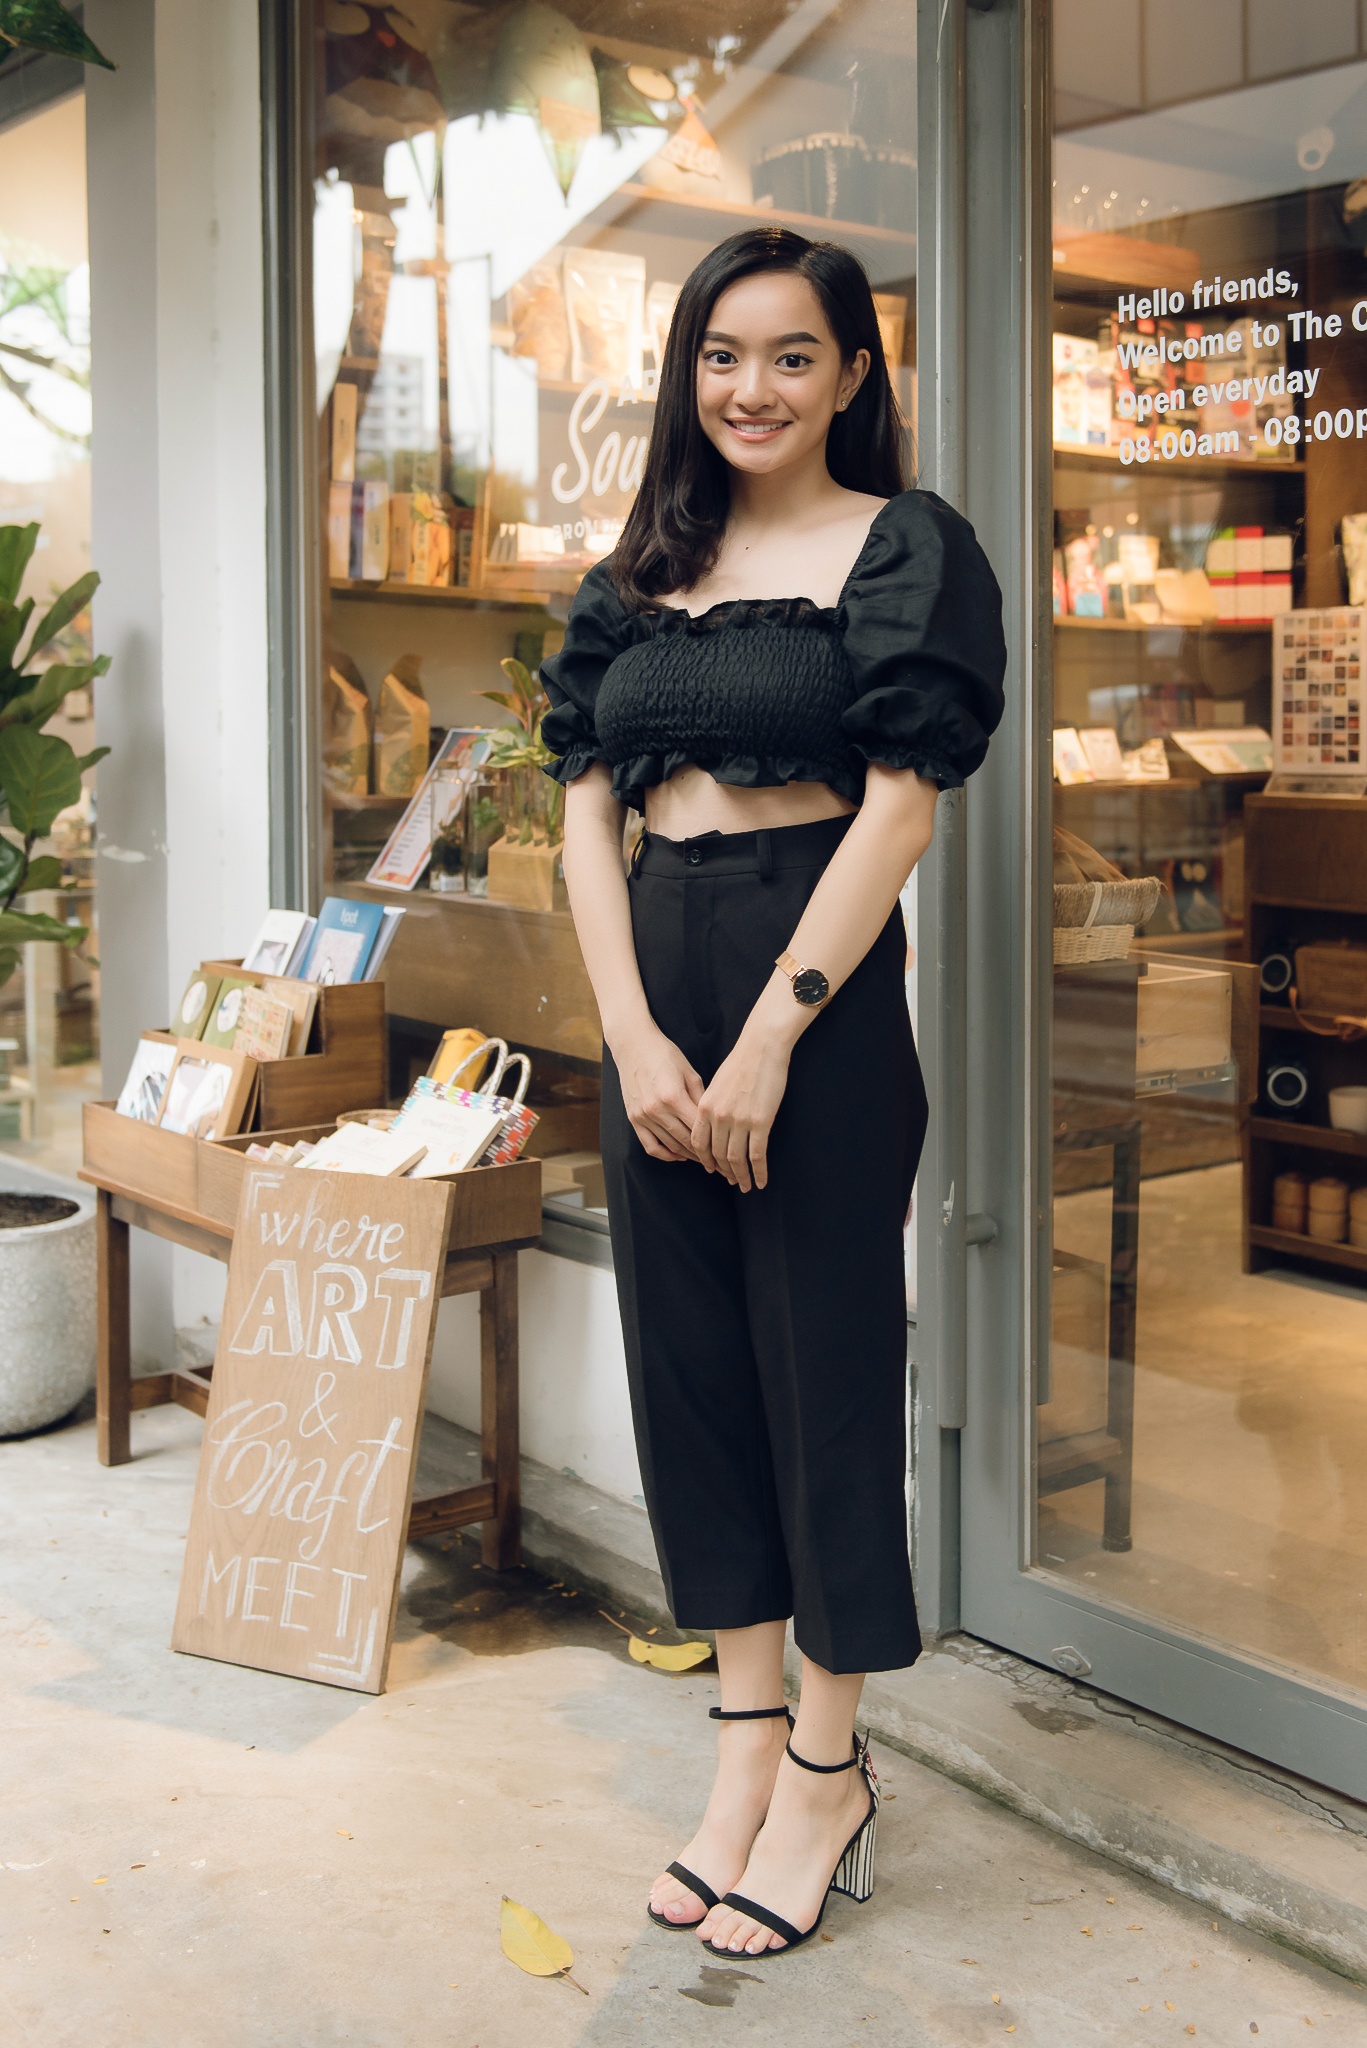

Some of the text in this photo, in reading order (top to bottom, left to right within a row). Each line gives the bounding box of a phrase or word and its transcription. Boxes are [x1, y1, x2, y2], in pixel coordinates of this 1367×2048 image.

[1117, 268, 1299, 323] Hello friends,
[1117, 330, 1242, 370] Welcome
[1250, 320, 1280, 349] to
[1287, 310, 1342, 342] The
[1118, 366, 1321, 422] Open everyday
[1118, 429, 1239, 465] 08:00am
[1264, 408, 1367, 447] 08:00p
[260, 1178, 404, 1263] where
[228, 1259, 431, 1370] ART
[299, 1371, 338, 1444] &
[207, 1398, 409, 1562] Craft
[200, 1551, 368, 1639] MEET
